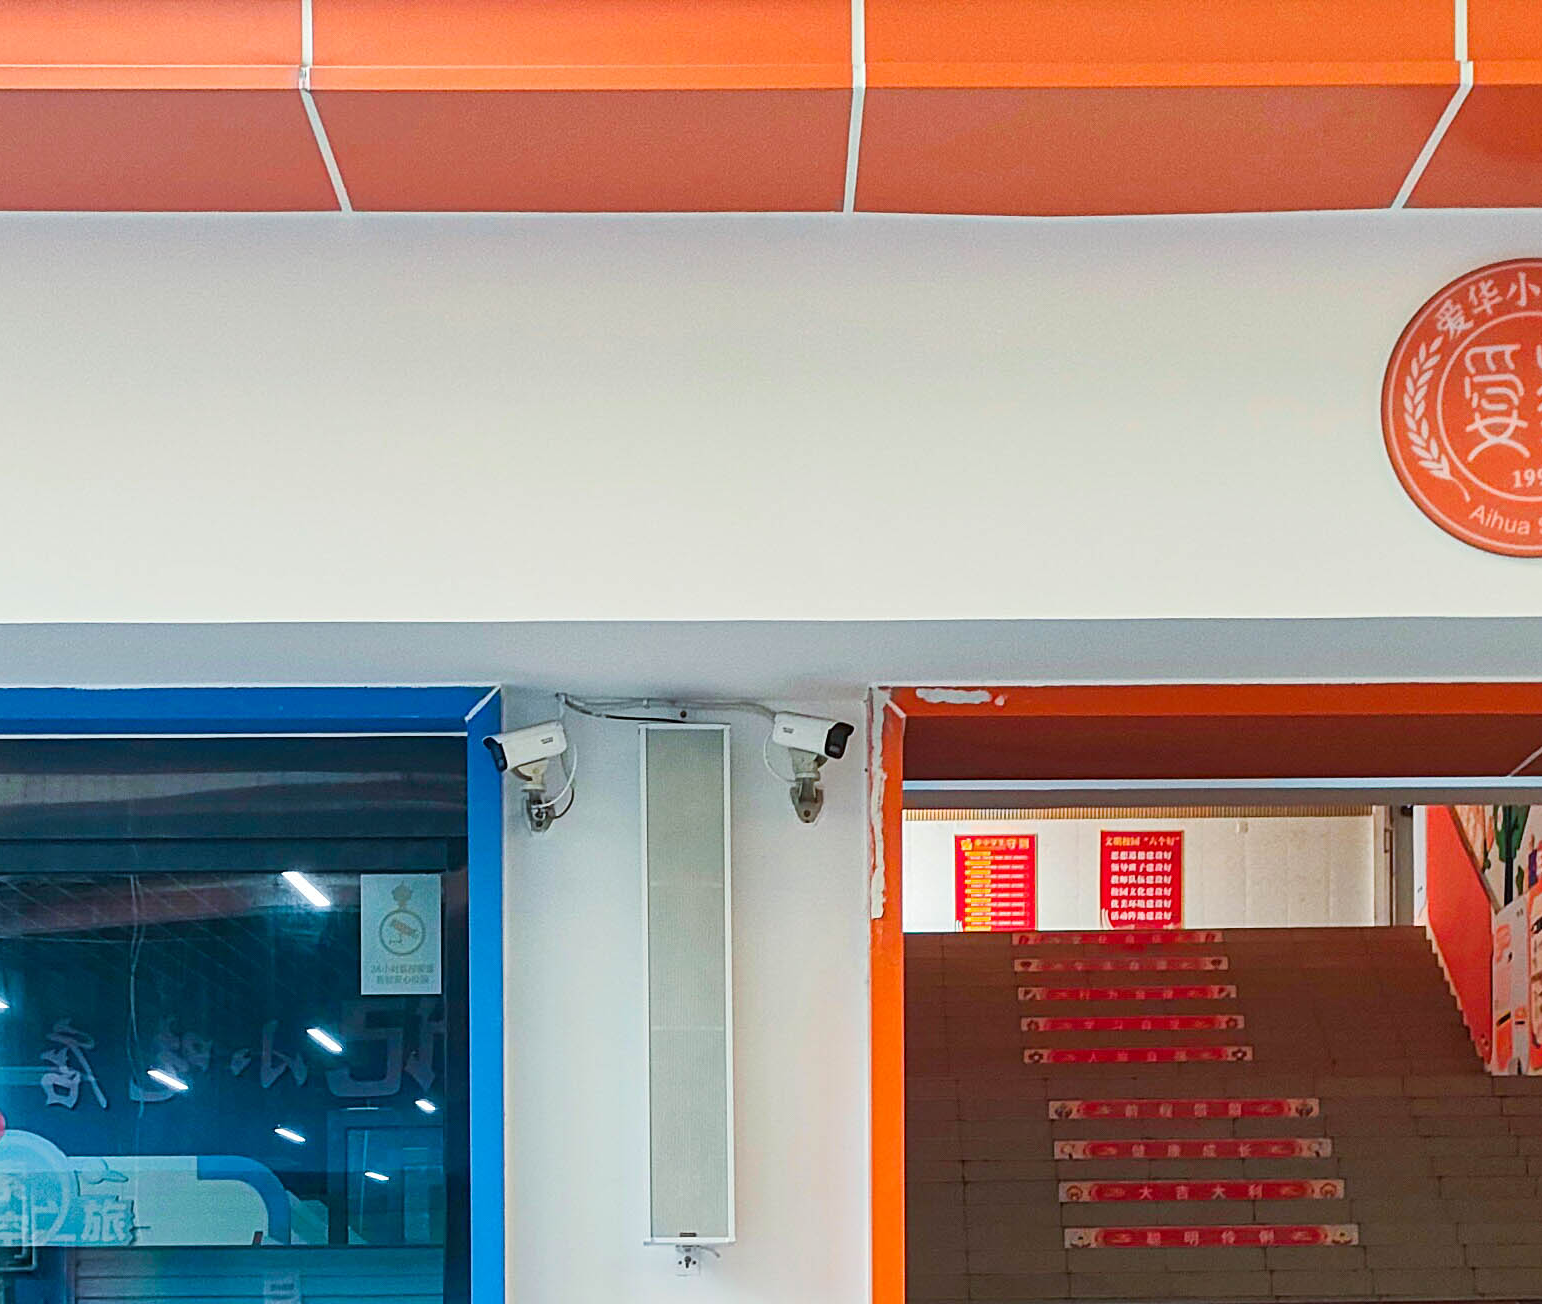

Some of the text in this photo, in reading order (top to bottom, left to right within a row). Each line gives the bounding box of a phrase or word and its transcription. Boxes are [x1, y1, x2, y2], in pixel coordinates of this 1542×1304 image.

[1468, 503, 1532, 536] Aihua
[1139, 1184, 1263, 1199] 大吉大利
[1147, 1230, 1275, 1245] 聪明伶俐
